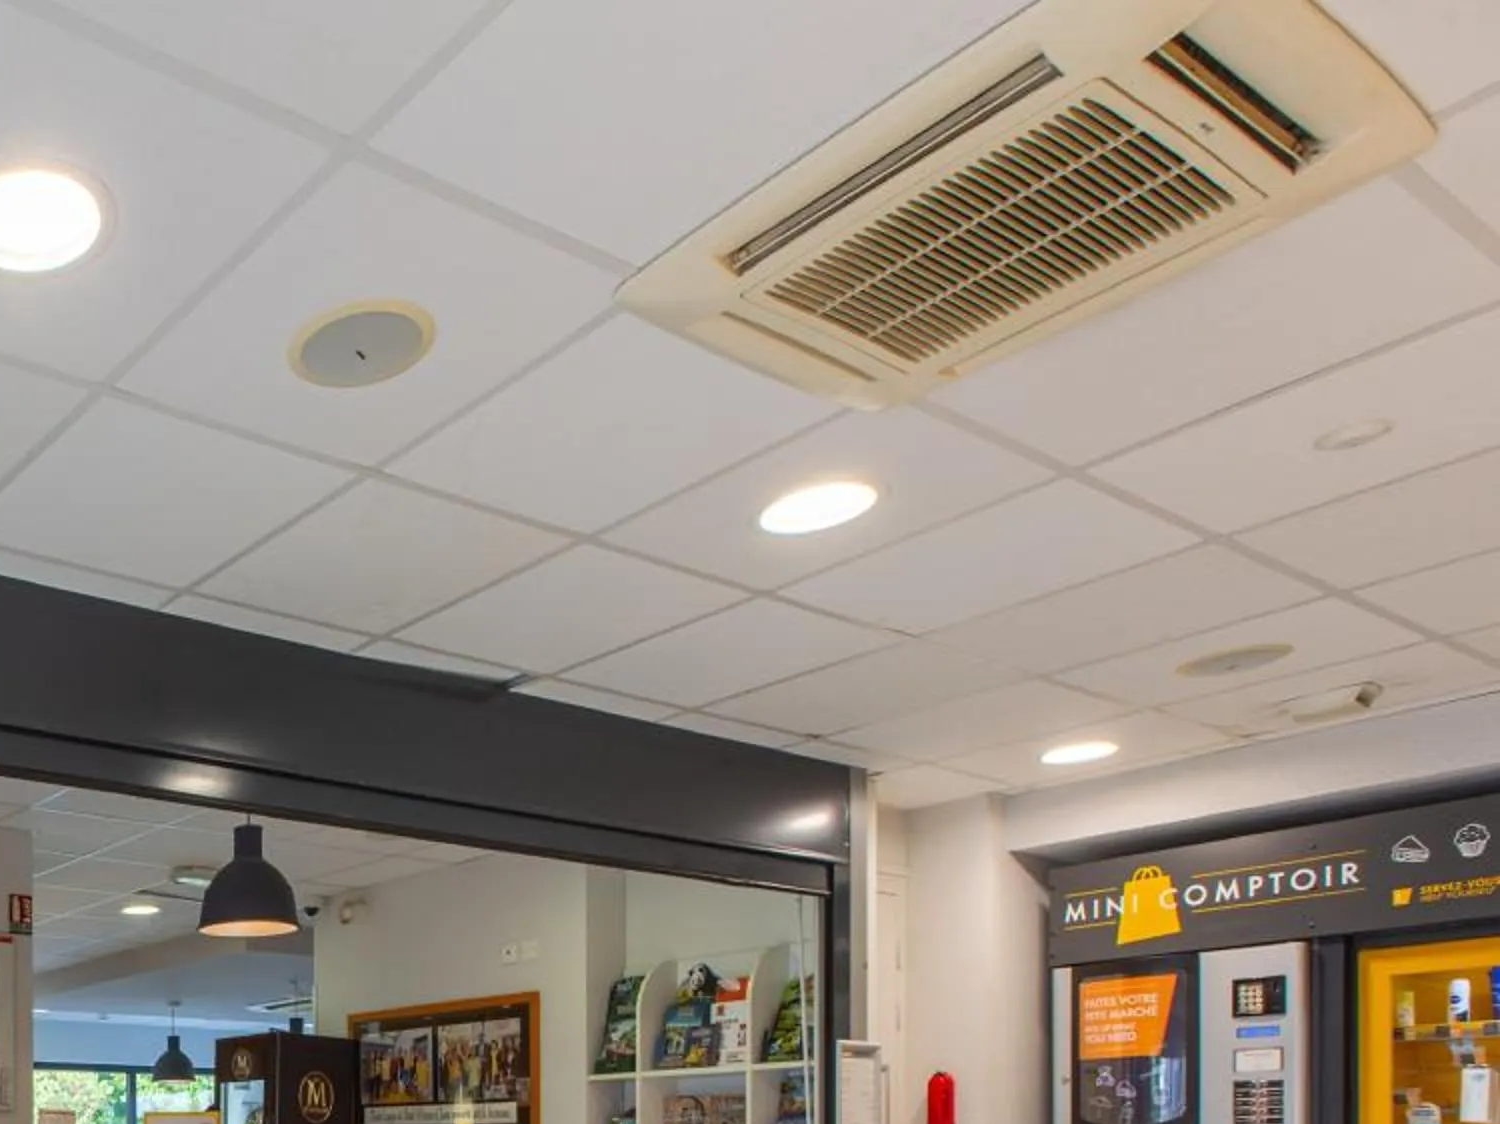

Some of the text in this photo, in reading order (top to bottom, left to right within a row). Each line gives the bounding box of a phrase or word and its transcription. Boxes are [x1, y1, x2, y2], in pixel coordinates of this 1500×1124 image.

[1063, 861, 1361, 924] MINI COMPTOIR
[1118, 993, 1157, 1005] VOTRE
